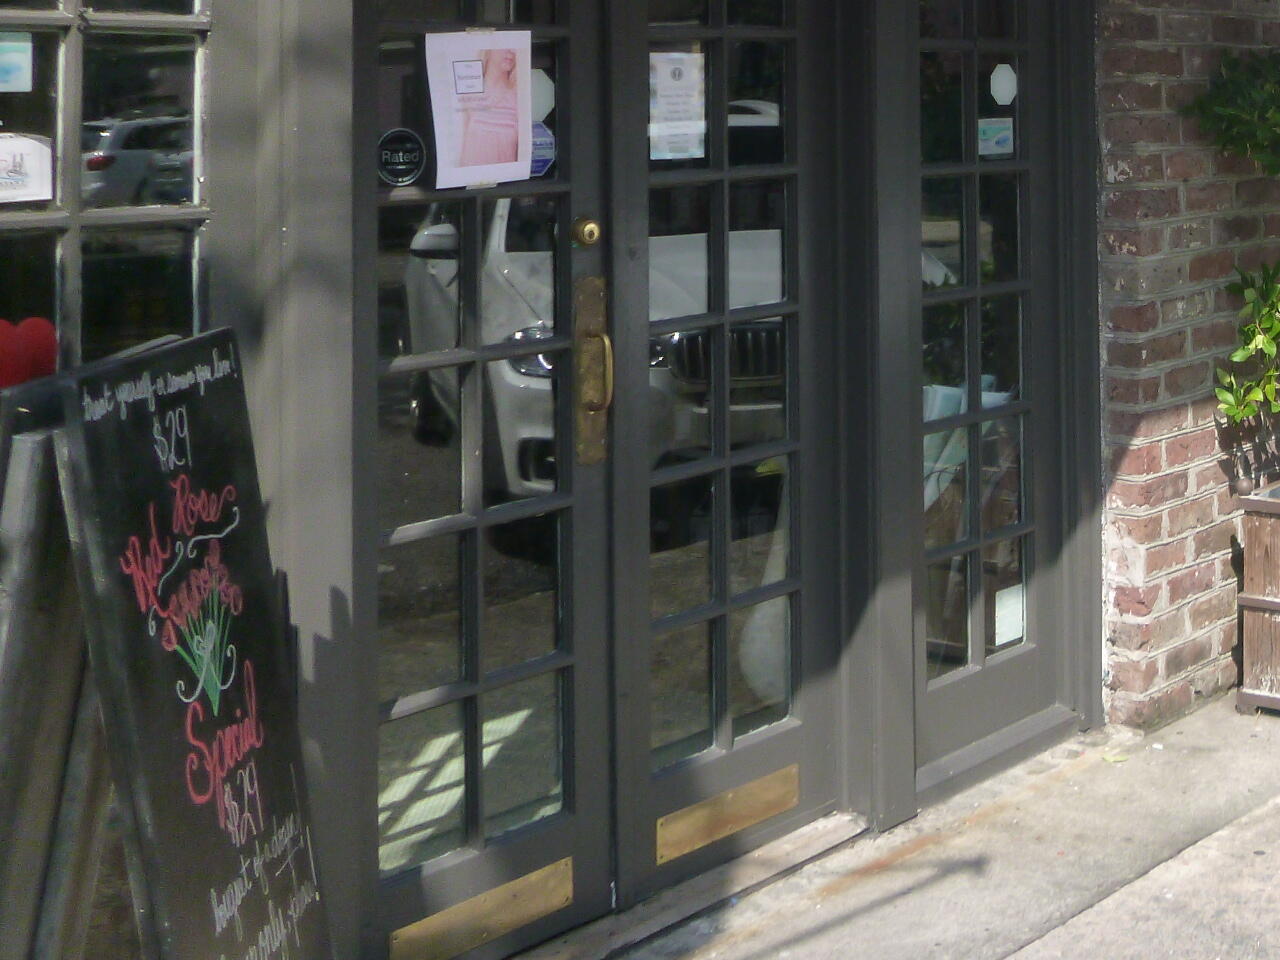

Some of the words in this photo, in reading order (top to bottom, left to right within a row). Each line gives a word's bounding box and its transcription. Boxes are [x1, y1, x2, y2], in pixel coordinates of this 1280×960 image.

[382, 150, 419, 163] Rated
[153, 404, 192, 472] $29
[185, 659, 264, 829] Special
